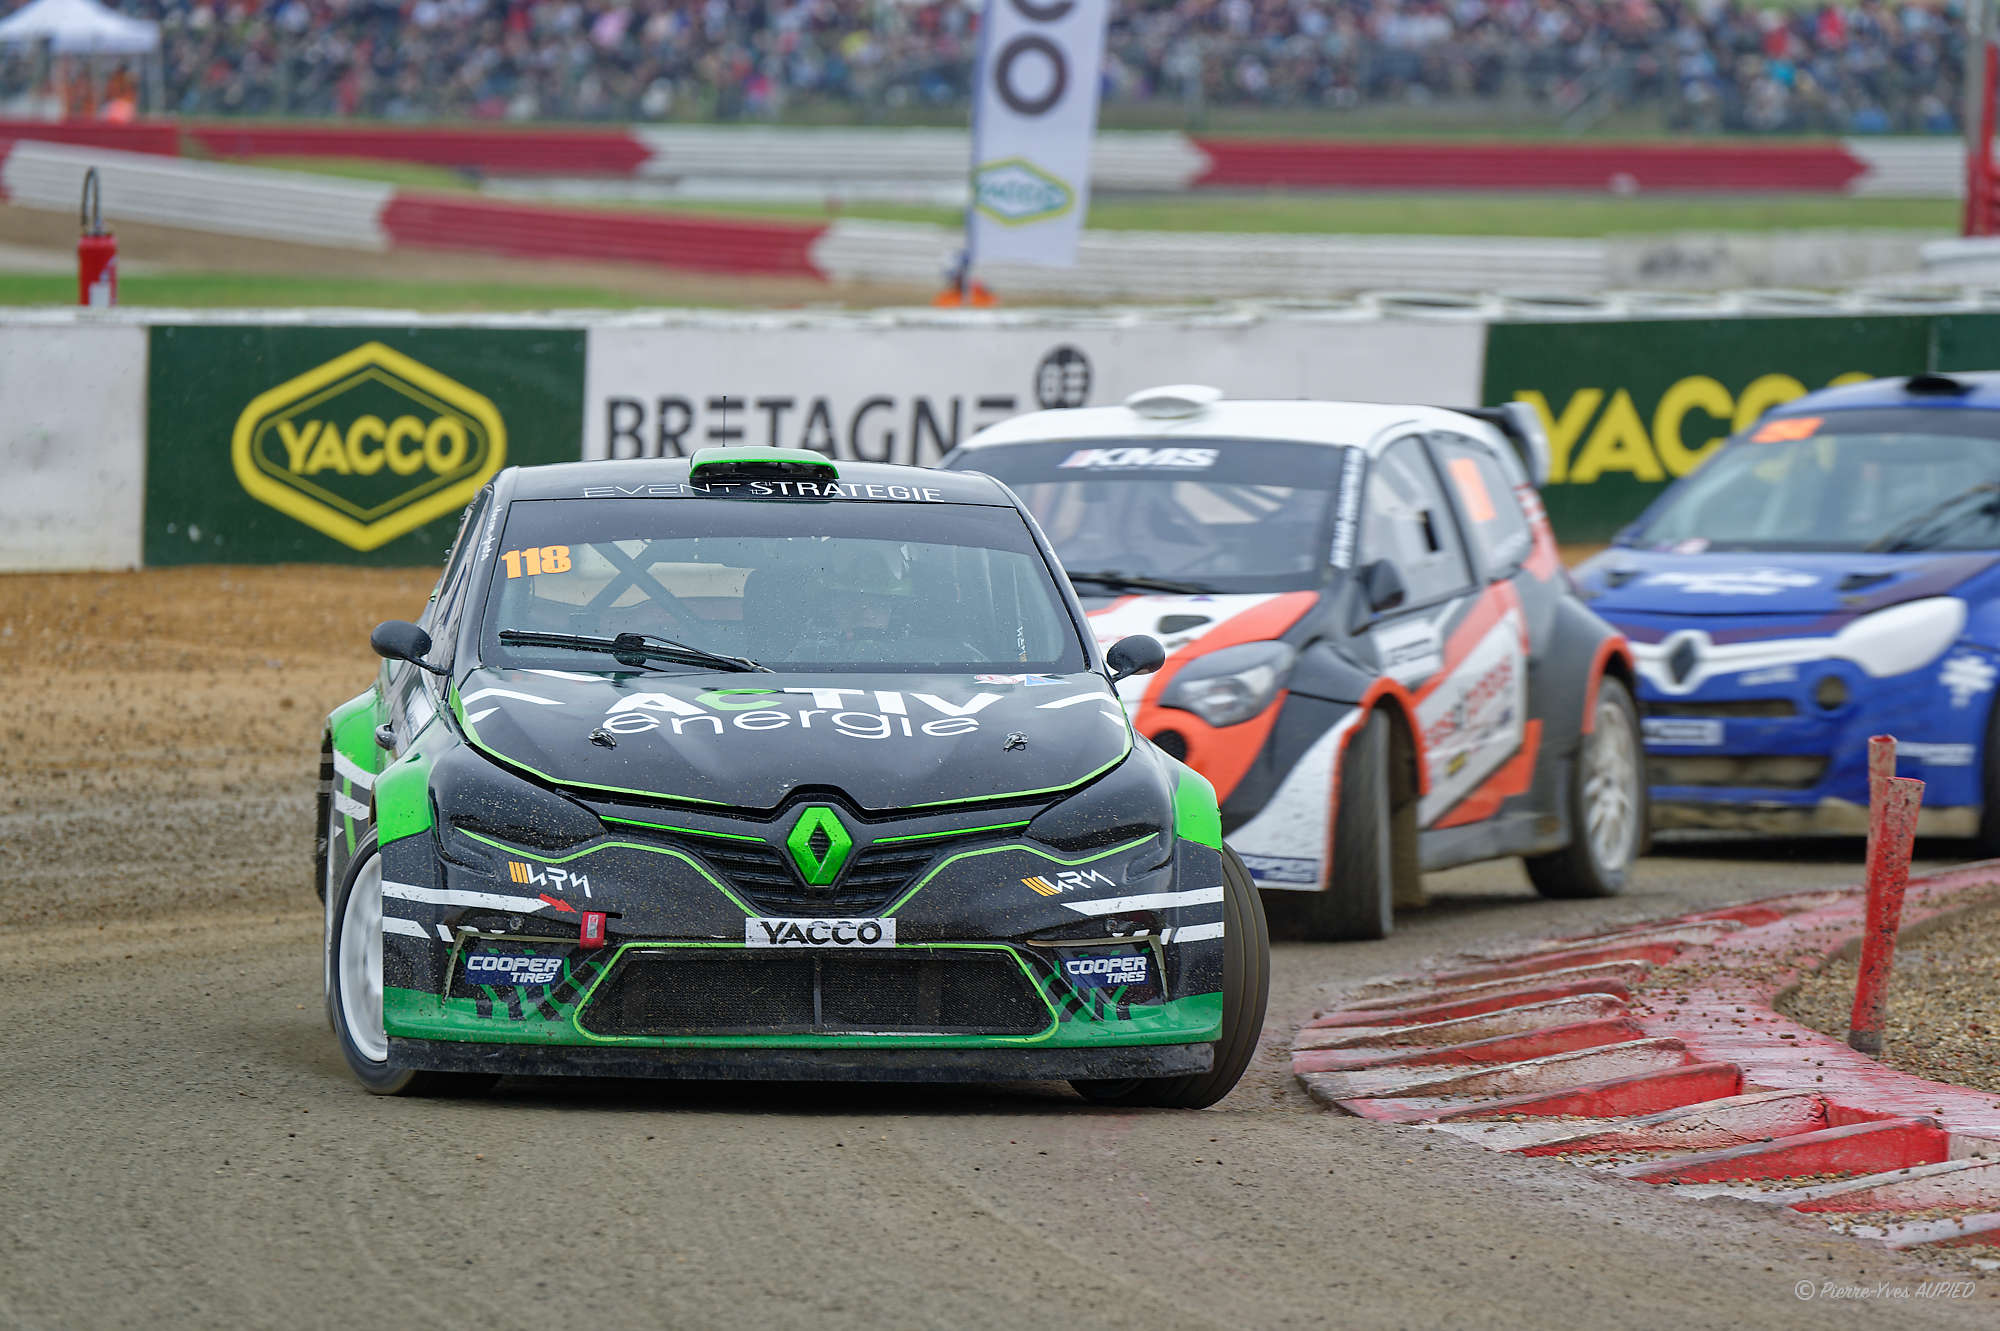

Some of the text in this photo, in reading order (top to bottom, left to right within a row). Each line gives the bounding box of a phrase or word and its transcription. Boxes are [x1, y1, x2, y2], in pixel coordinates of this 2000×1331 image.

[276, 413, 469, 476] YACCO
[1074, 447, 1220, 468] KMS
[583, 481, 945, 503] EVENT STRATEGIE
[501, 544, 572, 579] 118
[605, 687, 1006, 717] ACTIV
[760, 920, 883, 945] YACCO
[467, 956, 563, 973] COOPER
[1065, 956, 1148, 975] COOPER
[510, 972, 557, 984] TIRES
[1105, 971, 1147, 984] TIRES
